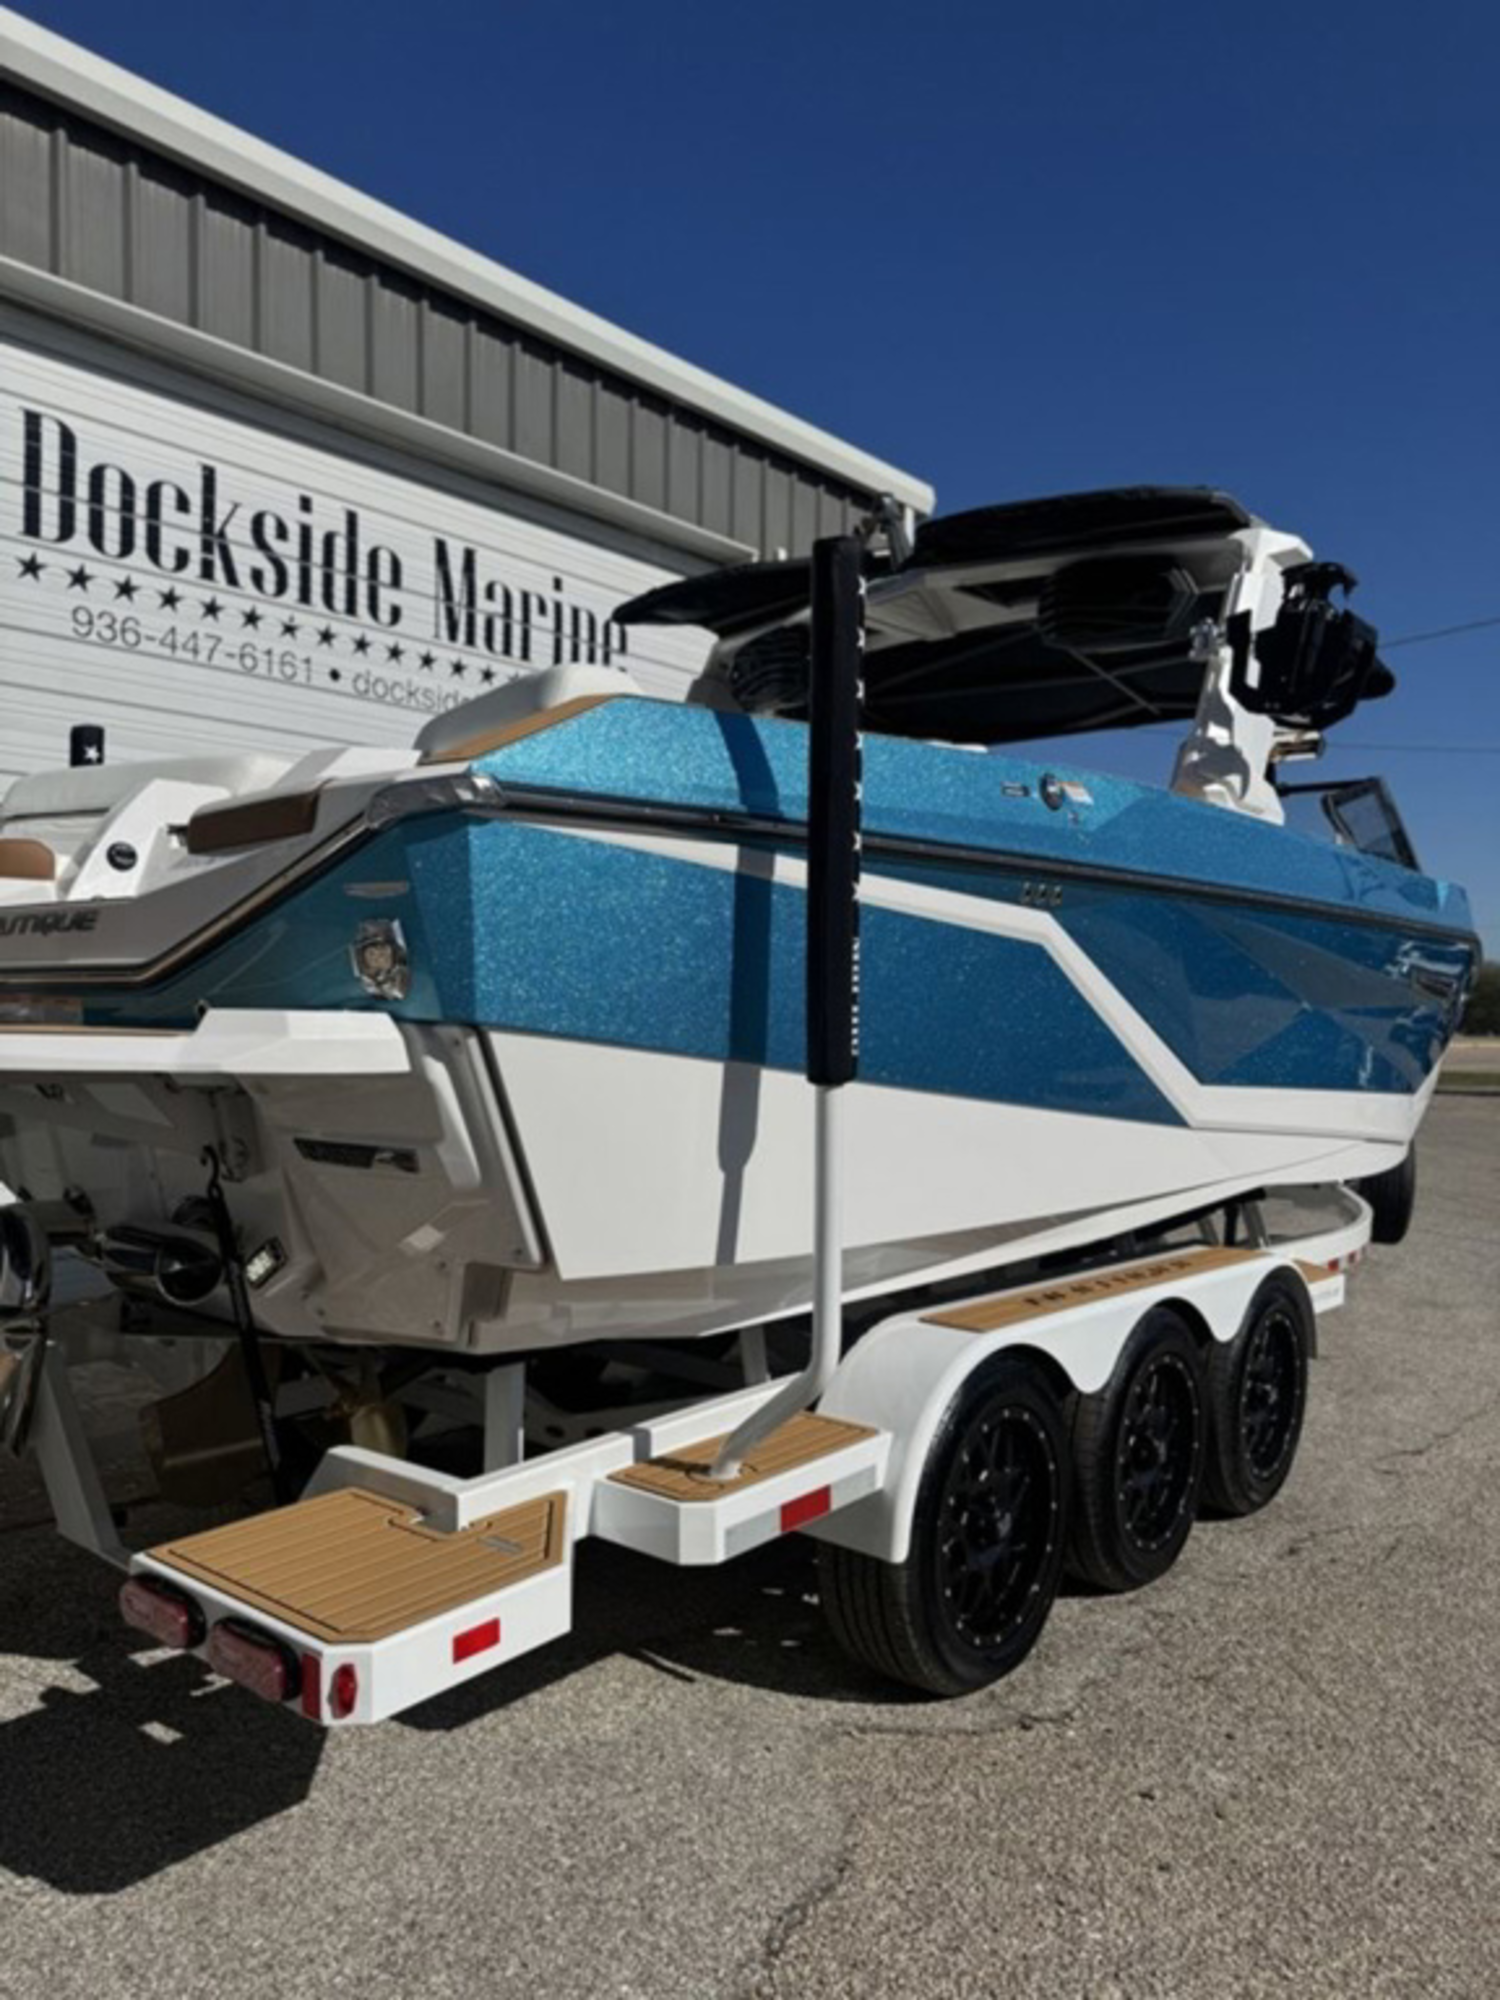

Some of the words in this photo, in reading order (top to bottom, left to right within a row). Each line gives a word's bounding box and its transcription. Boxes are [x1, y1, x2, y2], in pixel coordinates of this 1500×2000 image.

[18, 407, 403, 627] Dockside
[434, 536, 627, 672] Marine
[71, 605, 313, 683] 936-447-6161
